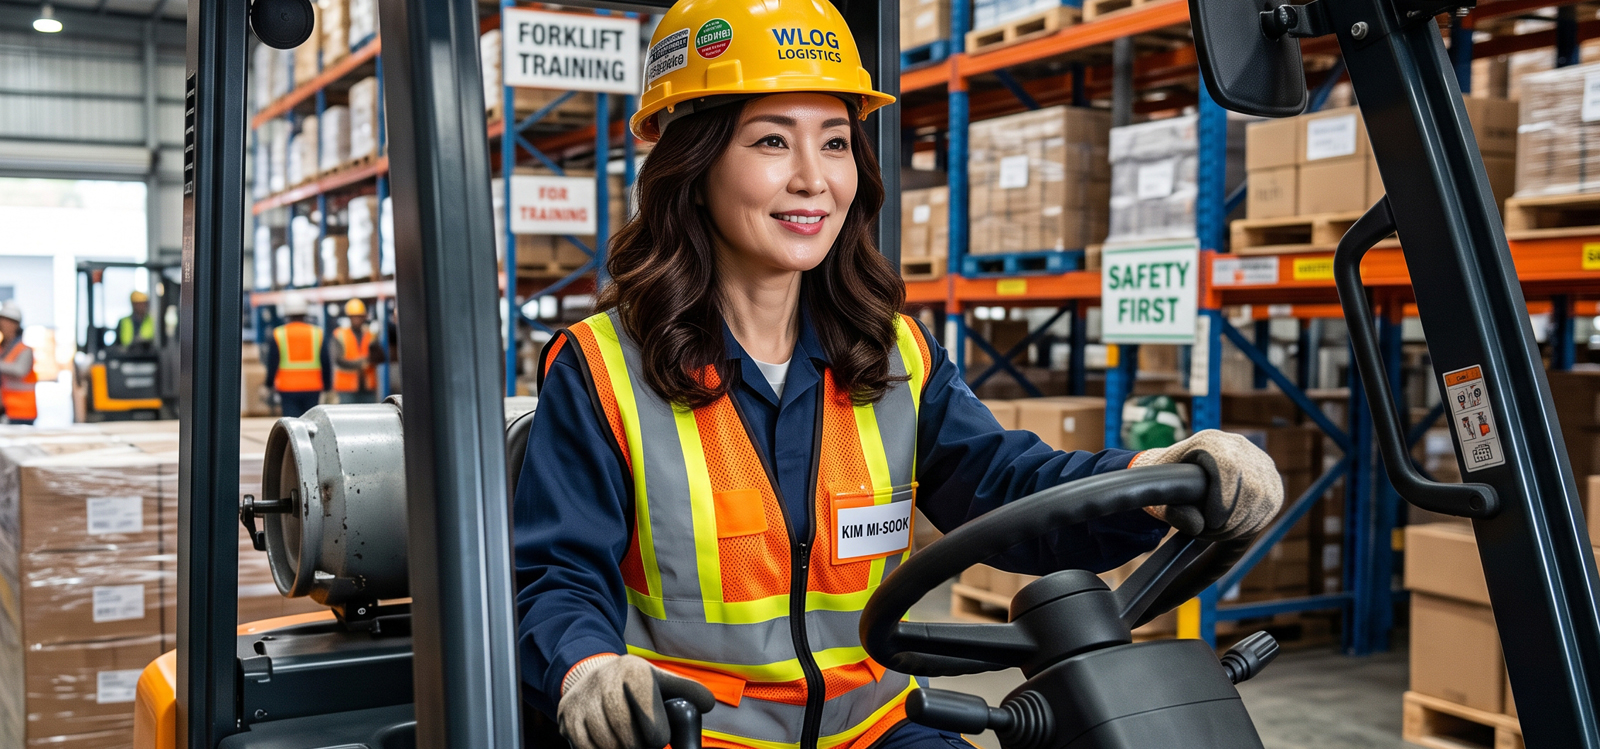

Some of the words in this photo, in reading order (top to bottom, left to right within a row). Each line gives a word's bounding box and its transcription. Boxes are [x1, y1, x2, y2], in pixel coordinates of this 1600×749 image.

[518, 22, 623, 51] FORKLIFT
[771, 28, 840, 50] WLOG
[777, 48, 842, 63] LOGISTICS
[518, 53, 625, 82] TRAINING
[538, 186, 568, 201] FOR
[520, 206, 588, 223] TRAINING
[1108, 260, 1190, 291] SAFETY
[1117, 297, 1180, 325] FIRST
[841, 524, 864, 539] KIM
[866, 516, 910, 537] MI-SOOK
